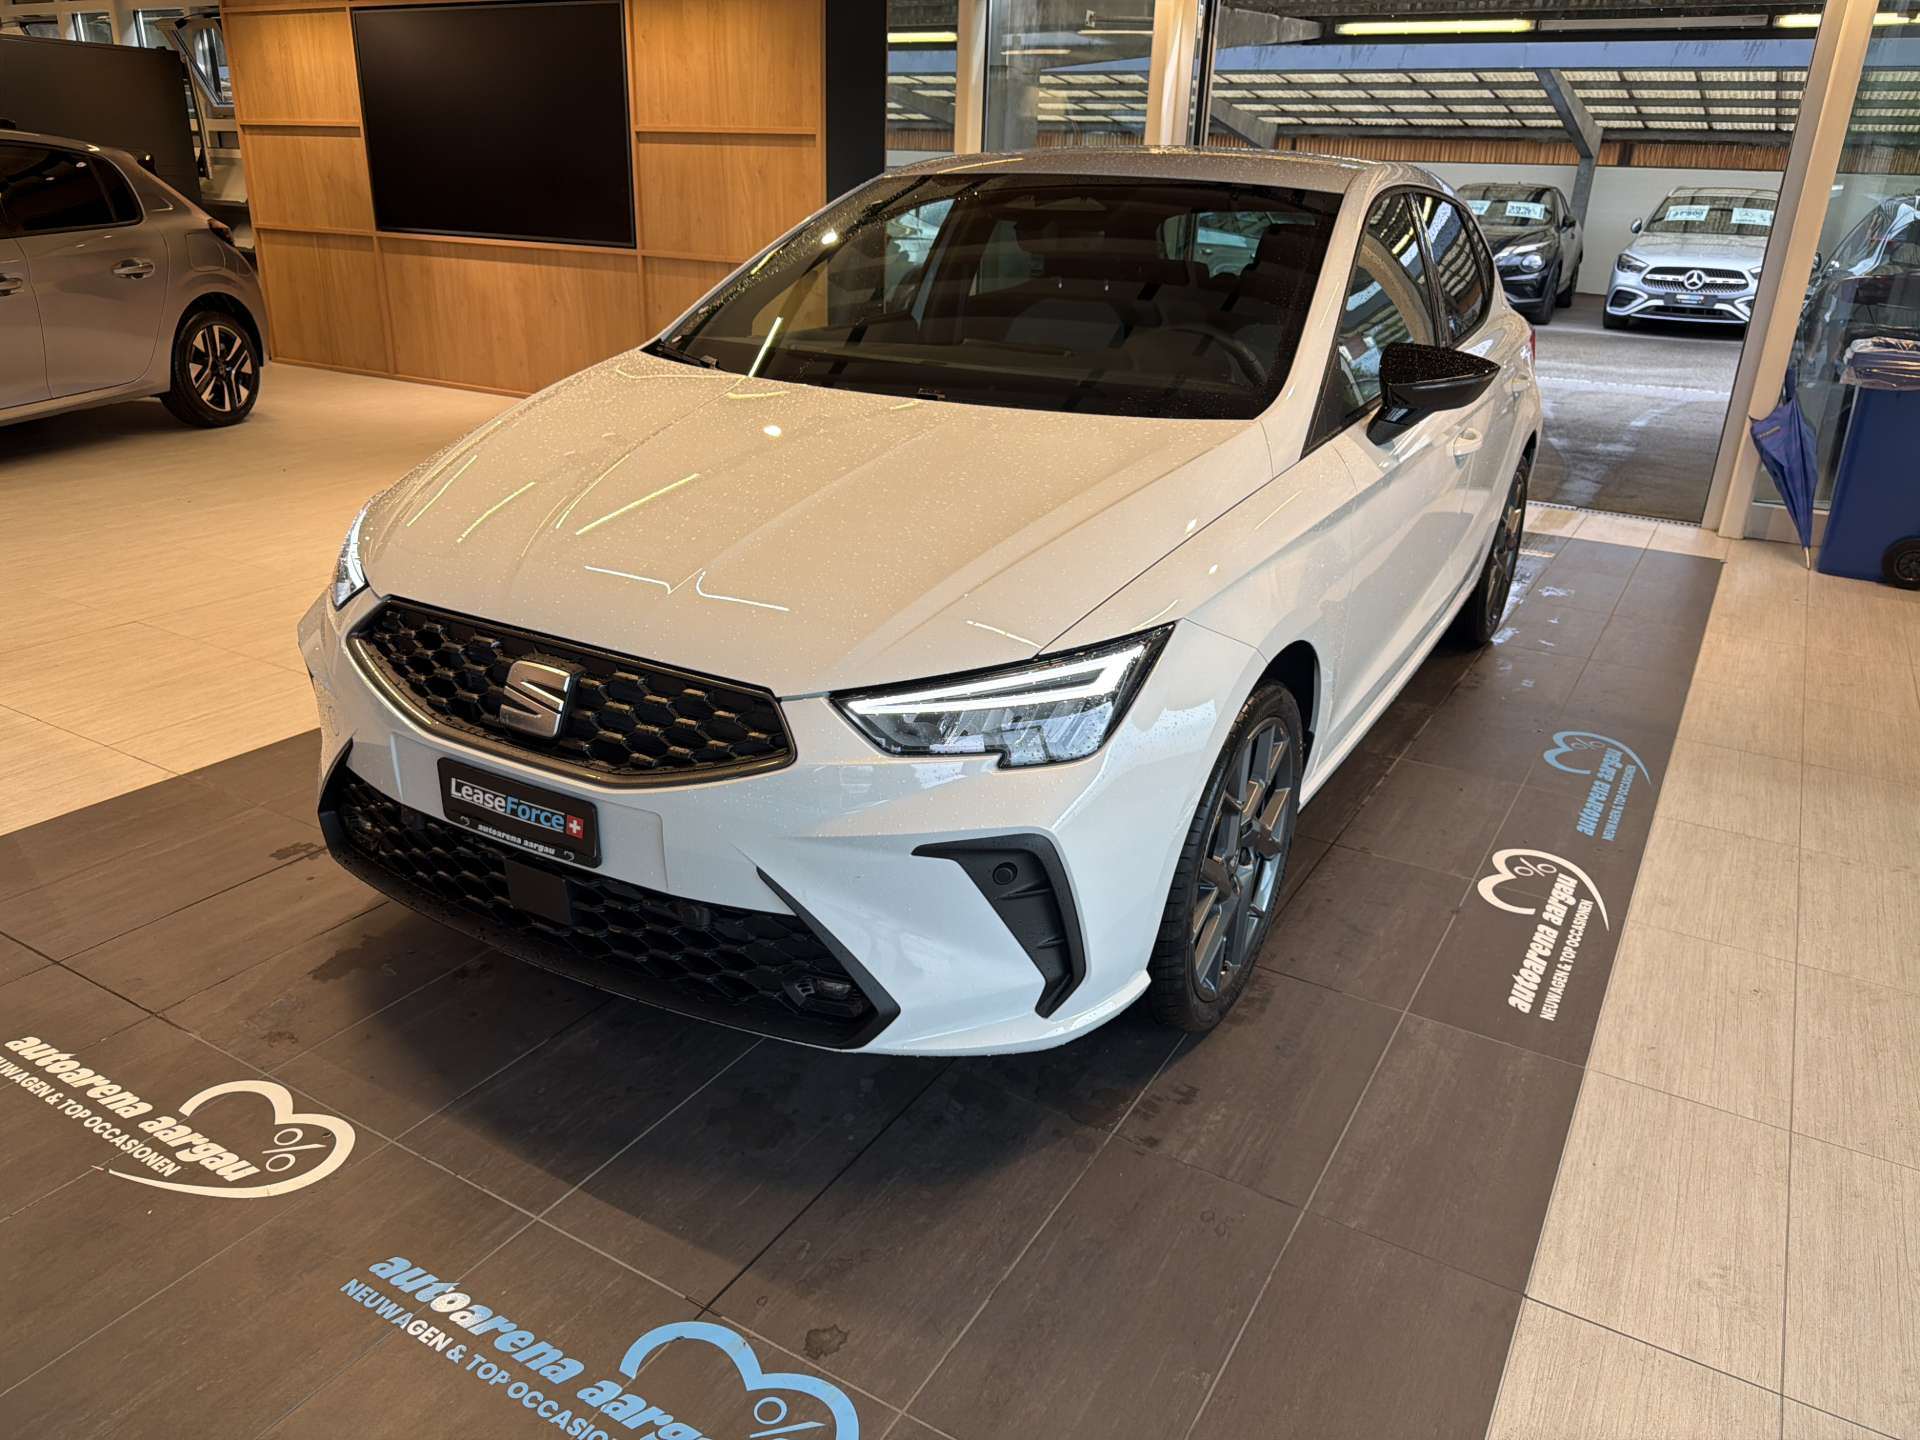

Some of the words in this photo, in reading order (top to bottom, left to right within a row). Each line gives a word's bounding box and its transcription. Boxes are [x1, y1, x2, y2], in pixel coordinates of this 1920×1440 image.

[451, 777, 565, 829] LeaseForce
[1576, 780, 1611, 836] autoarena
[477, 824, 522, 844] autoarena
[523, 840, 556, 855] aargau
[1508, 924, 1559, 1013] autoarena
[1542, 873, 1578, 926] aargau
[1565, 899, 1594, 948] OCCASIONEN
[1557, 963, 1573, 972] &
[1559, 946, 1577, 964] TOP
[1540, 969, 1570, 1021] NEUWAGEN
[0, 1056, 55, 1098] UWAGEN
[45, 1093, 64, 1105] &
[57, 1099, 92, 1119] TOP
[83, 1116, 181, 1177] OCCASIONEN
[4, 1036, 153, 1119] autoarena
[138, 1115, 261, 1182] aargau
[340, 1278, 453, 1352] NEUWAGEN
[446, 1344, 468, 1364] &
[465, 1353, 511, 1386] TOP
[507, 1381, 619, 1440] OCCASIO
[368, 1256, 585, 1384] autoarena
[577, 1380, 708, 1440] aarg
